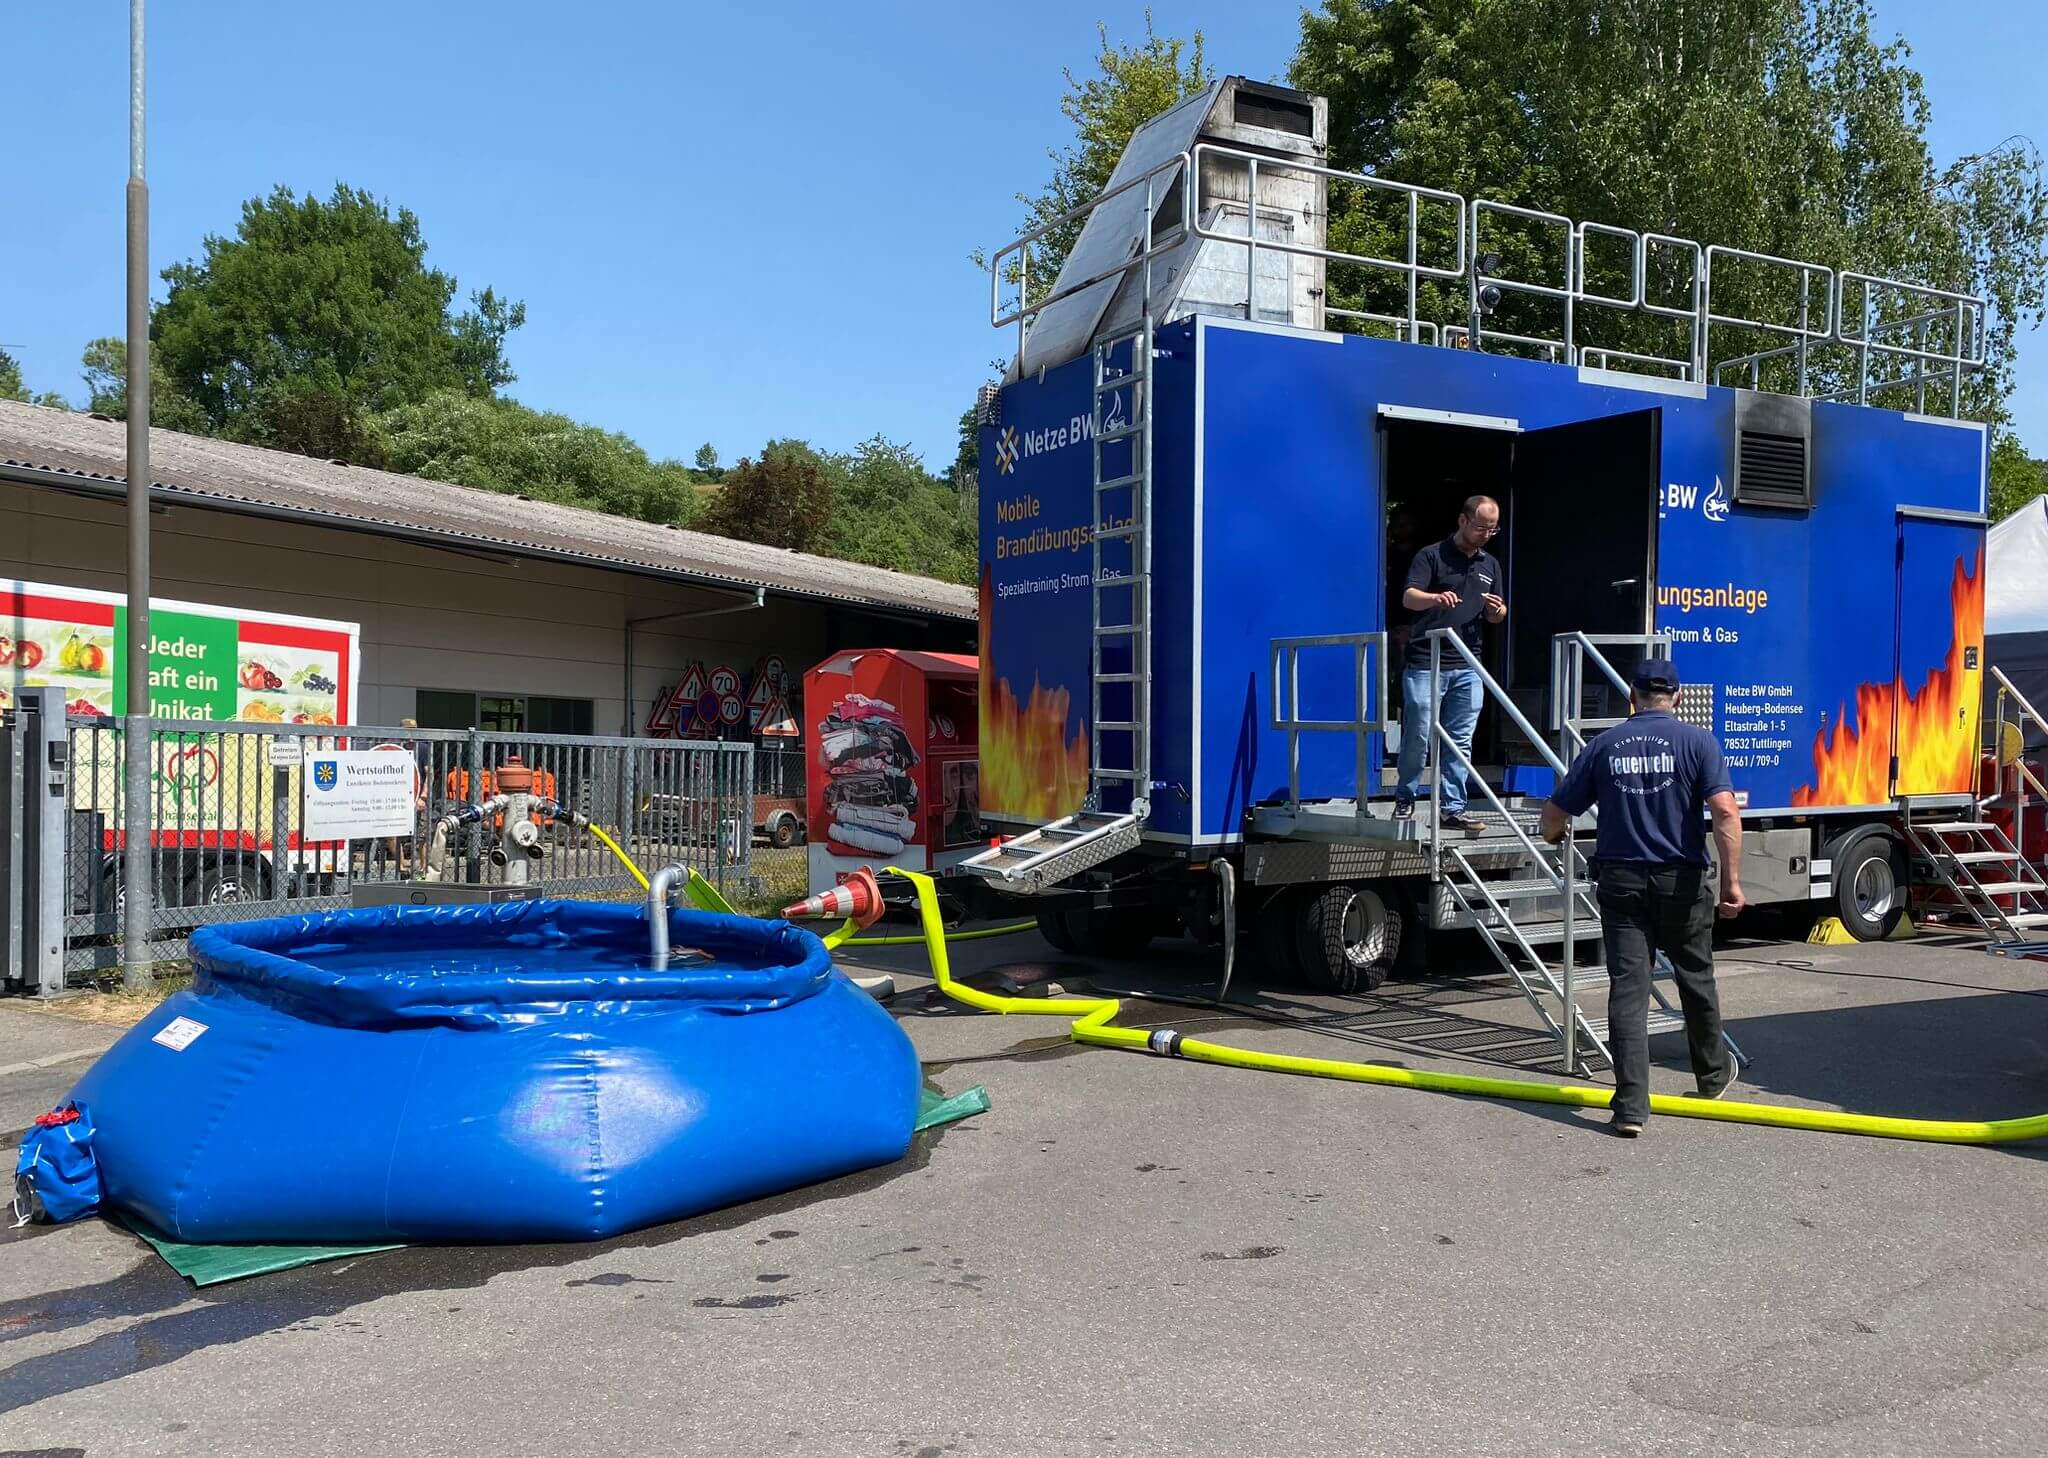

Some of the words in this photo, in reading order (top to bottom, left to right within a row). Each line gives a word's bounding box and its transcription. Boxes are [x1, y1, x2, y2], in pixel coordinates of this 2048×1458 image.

[1025, 429, 1067, 457] Netze
[1070, 413, 1094, 445] BW
[1668, 484, 1698, 509] BW
[997, 494, 1040, 523] Mobile
[998, 576, 1059, 600] Spezialtraining
[1061, 573, 1090, 589] Strom
[1658, 582, 1768, 614] ungsanlage
[1703, 627, 1712, 643] &
[1715, 627, 1739, 643] Gas
[149, 635, 207, 659] Jeder
[148, 667, 179, 688] aft
[185, 670, 218, 691] ein
[716, 677, 732, 691] 70
[1725, 685, 1750, 697] Netze
[1752, 685, 1766, 697] BW
[1768, 685, 1793, 697] GmbH
[724, 702, 738, 715] 70
[1725, 703, 1804, 717] Heuberg-Bodensee
[1725, 720, 1768, 732] Eltastraße
[1614, 735, 1669, 749] Freiwillige
[1724, 738, 1750, 749] 78532
[1751, 738, 1792, 751] Tuttlingen
[1609, 752, 1674, 776] Feuerwehr
[1756, 755, 1780, 767] 709-0
[346, 764, 406, 775] Wertstoffhof
